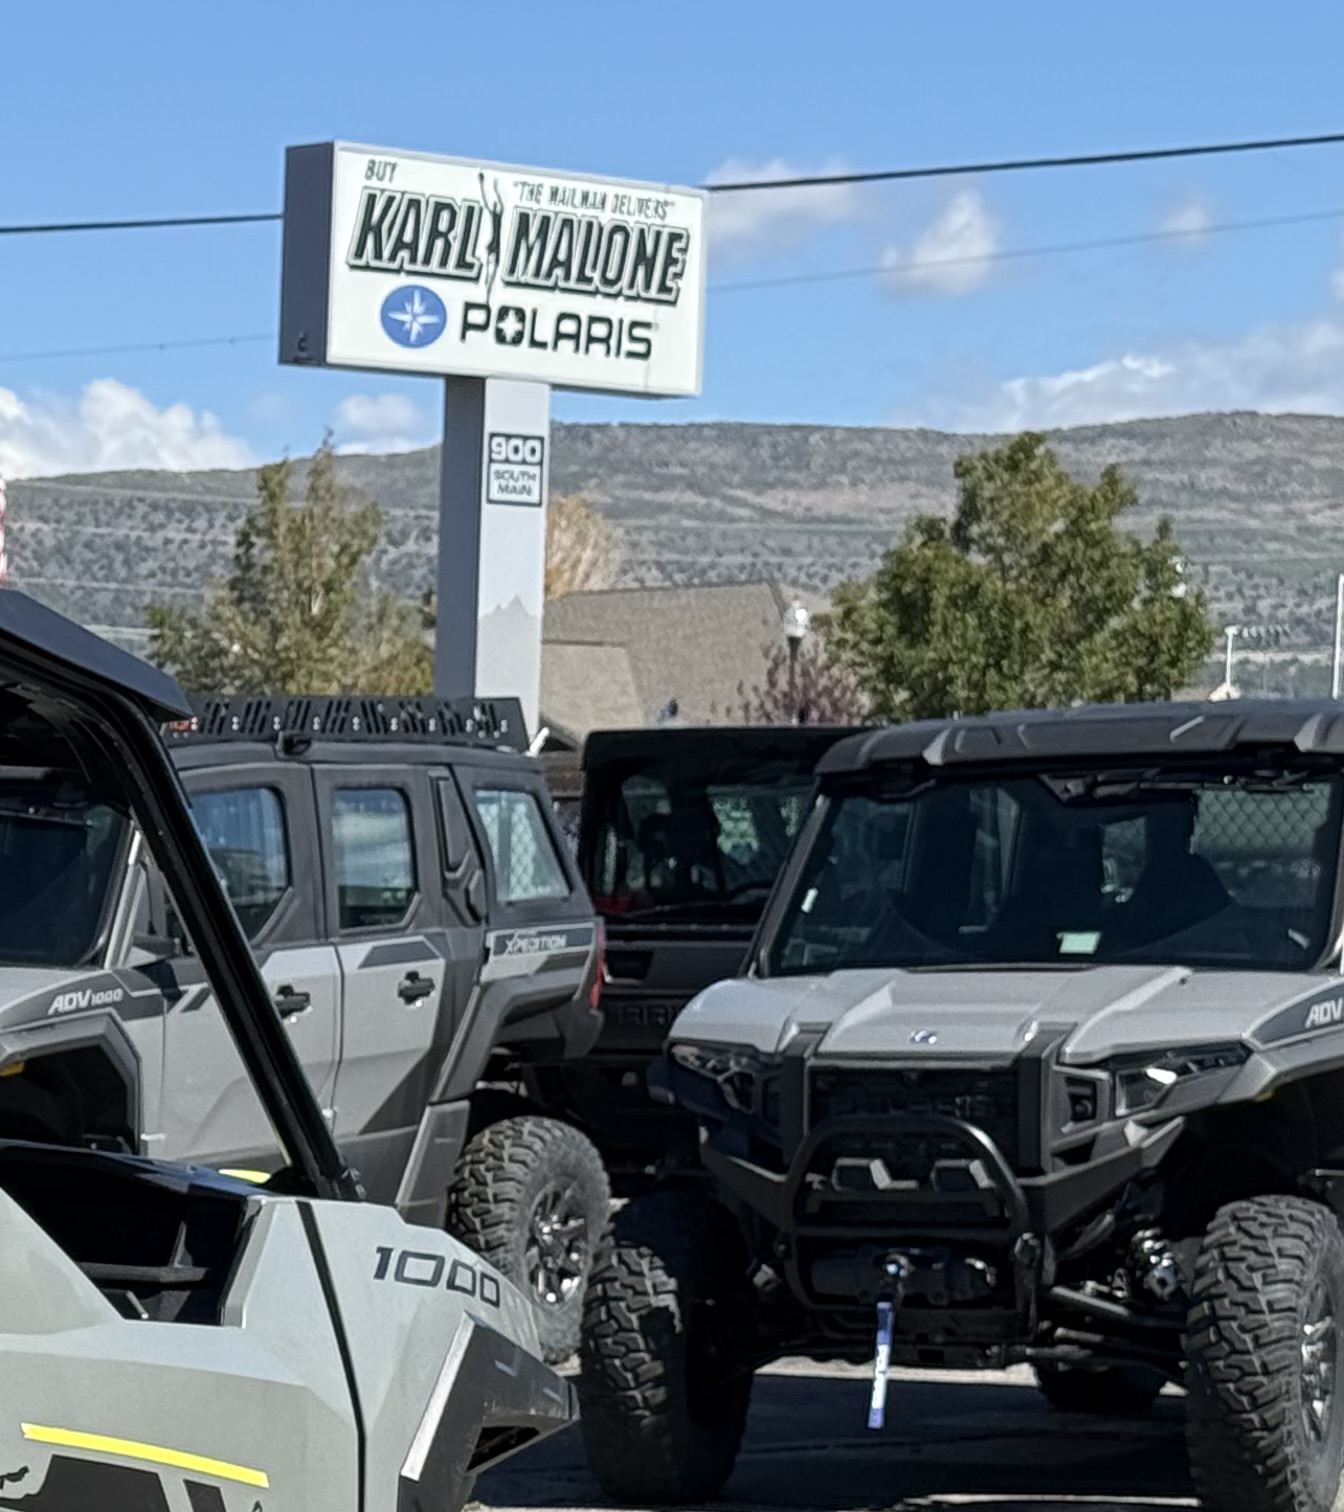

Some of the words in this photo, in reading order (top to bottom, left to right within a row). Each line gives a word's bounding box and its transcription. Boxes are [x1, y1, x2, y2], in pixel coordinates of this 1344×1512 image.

[364, 158, 398, 183] BUY
[347, 185, 484, 283] KARL
[502, 205, 692, 306] MALONE
[460, 300, 653, 362] POLARIS
[490, 435, 542, 464] 900
[1304, 997, 1344, 1029] ADV
[372, 1245, 501, 1310] 1000
